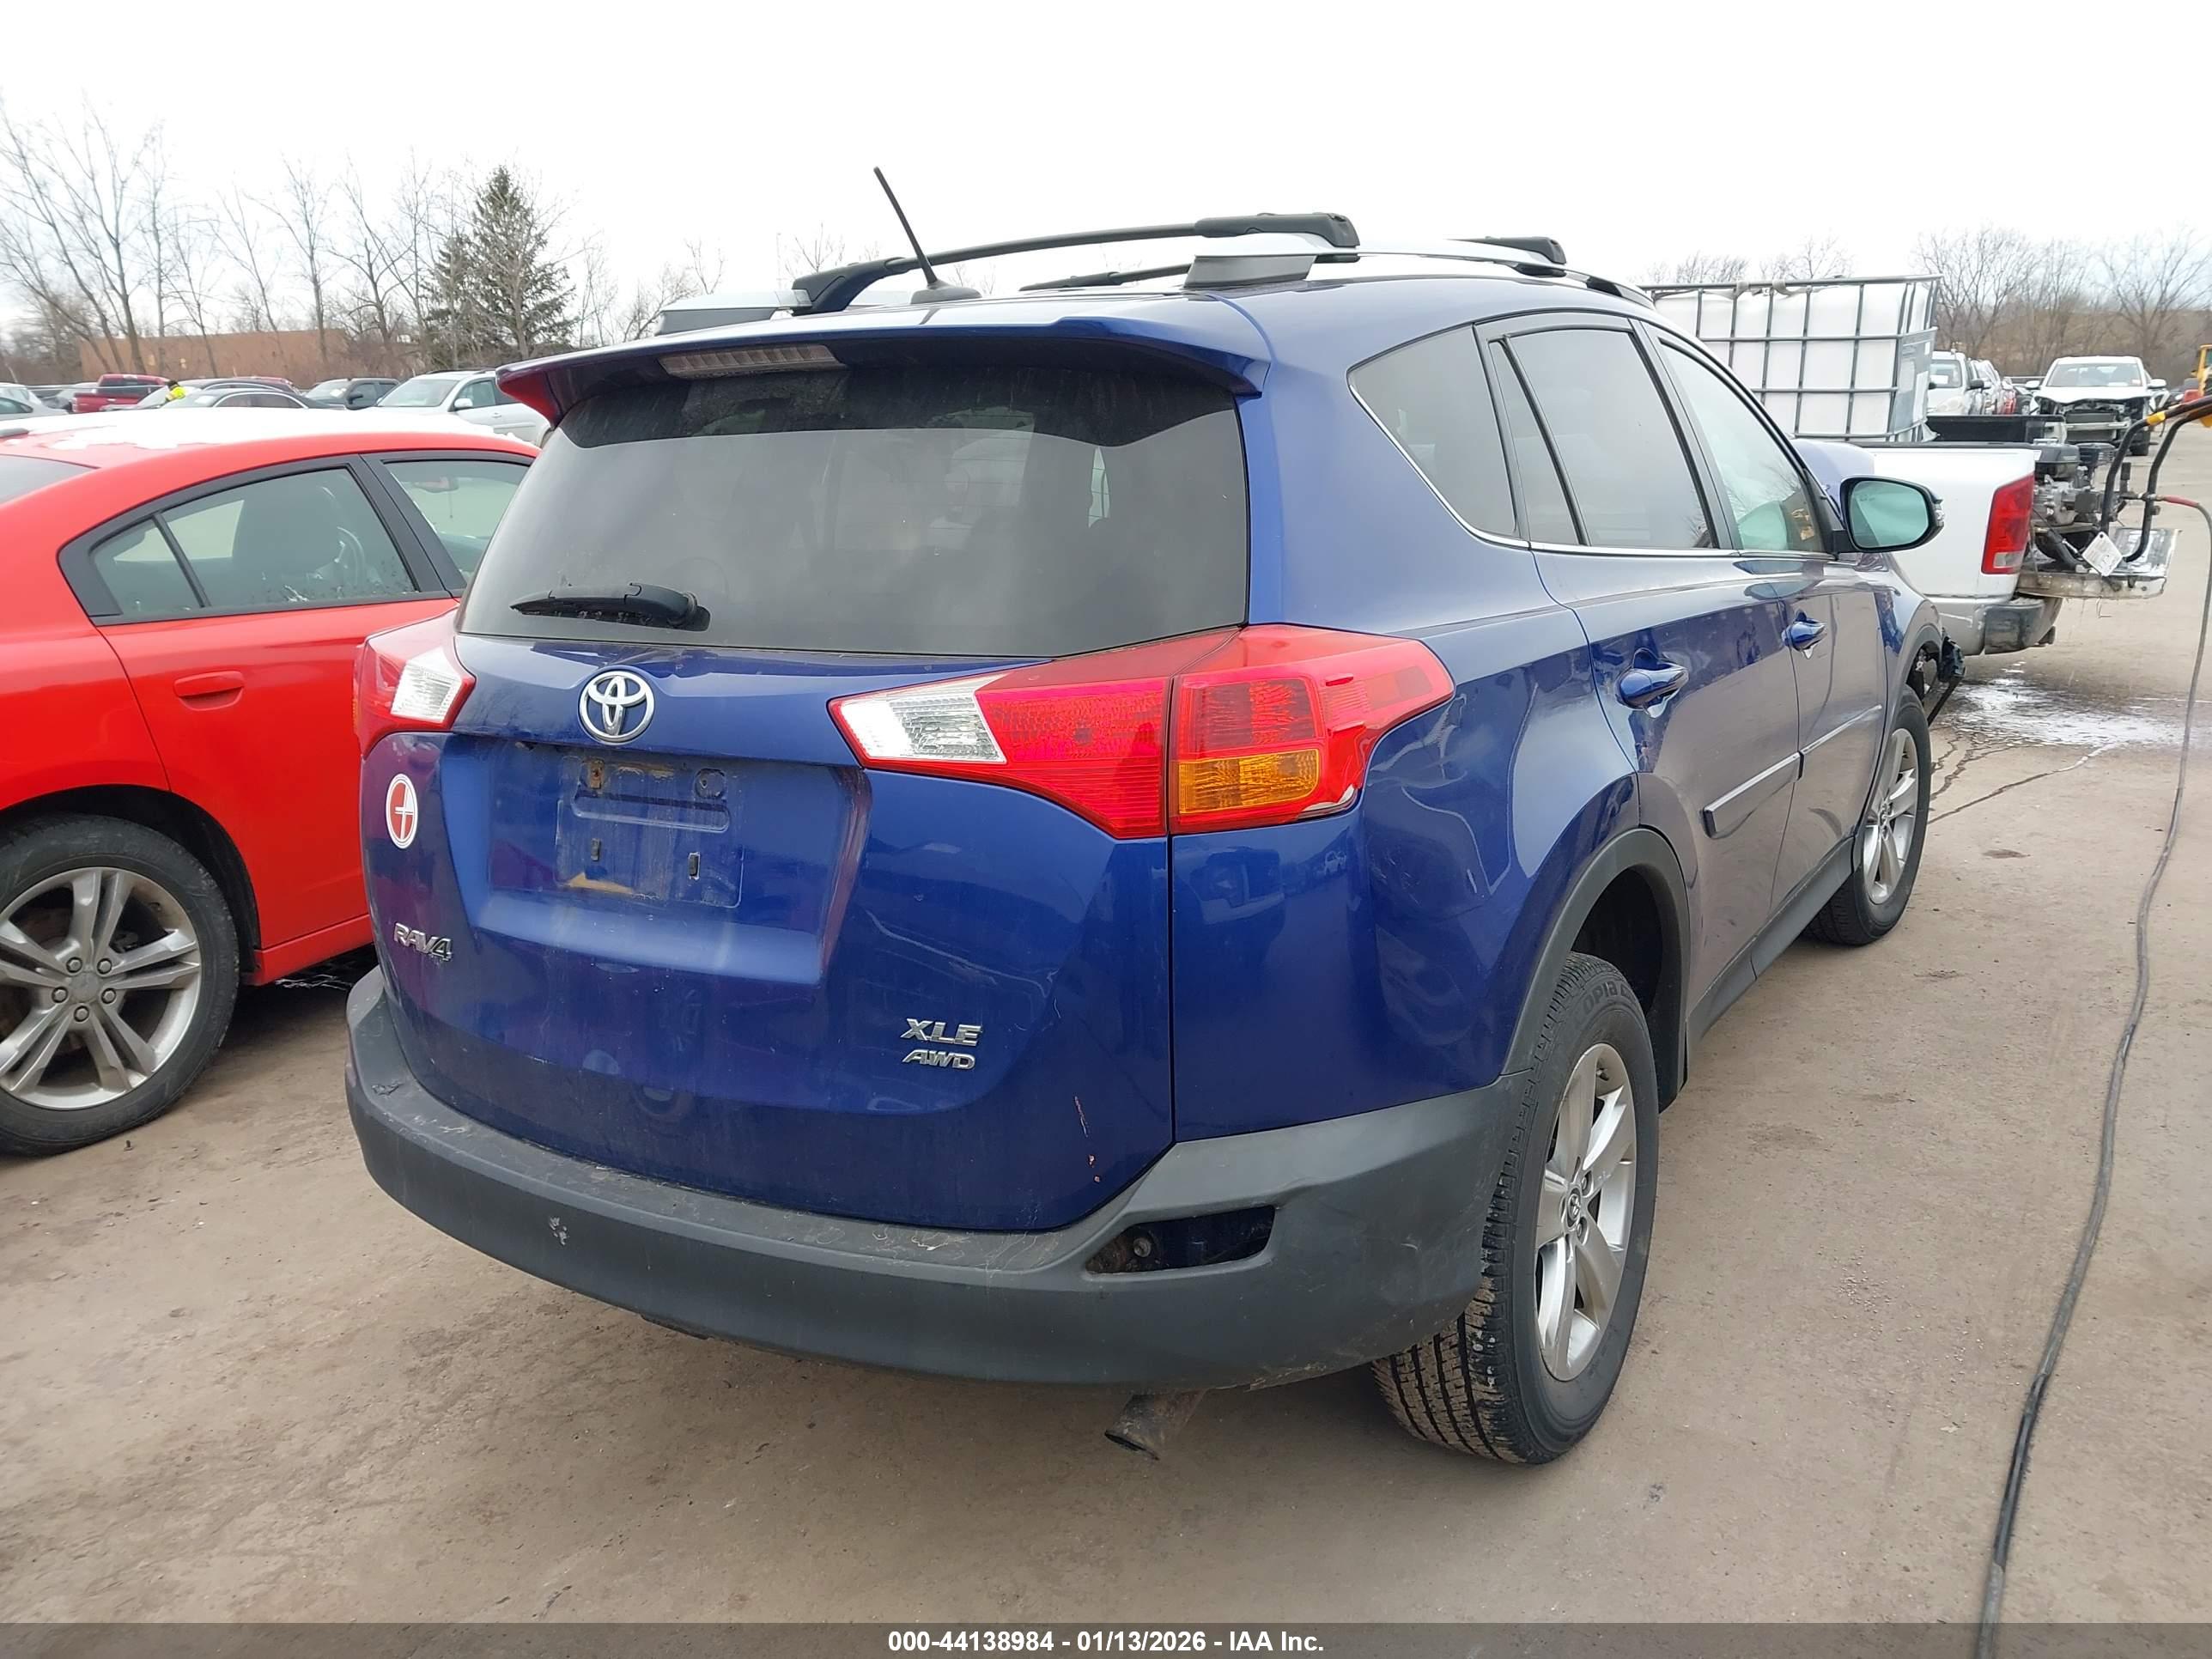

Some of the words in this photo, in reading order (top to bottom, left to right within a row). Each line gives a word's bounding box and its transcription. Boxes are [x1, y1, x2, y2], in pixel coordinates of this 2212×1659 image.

[394, 922, 452, 961] RAV4
[899, 1018, 981, 1047] XLE
[902, 1048, 975, 1070] AWD
